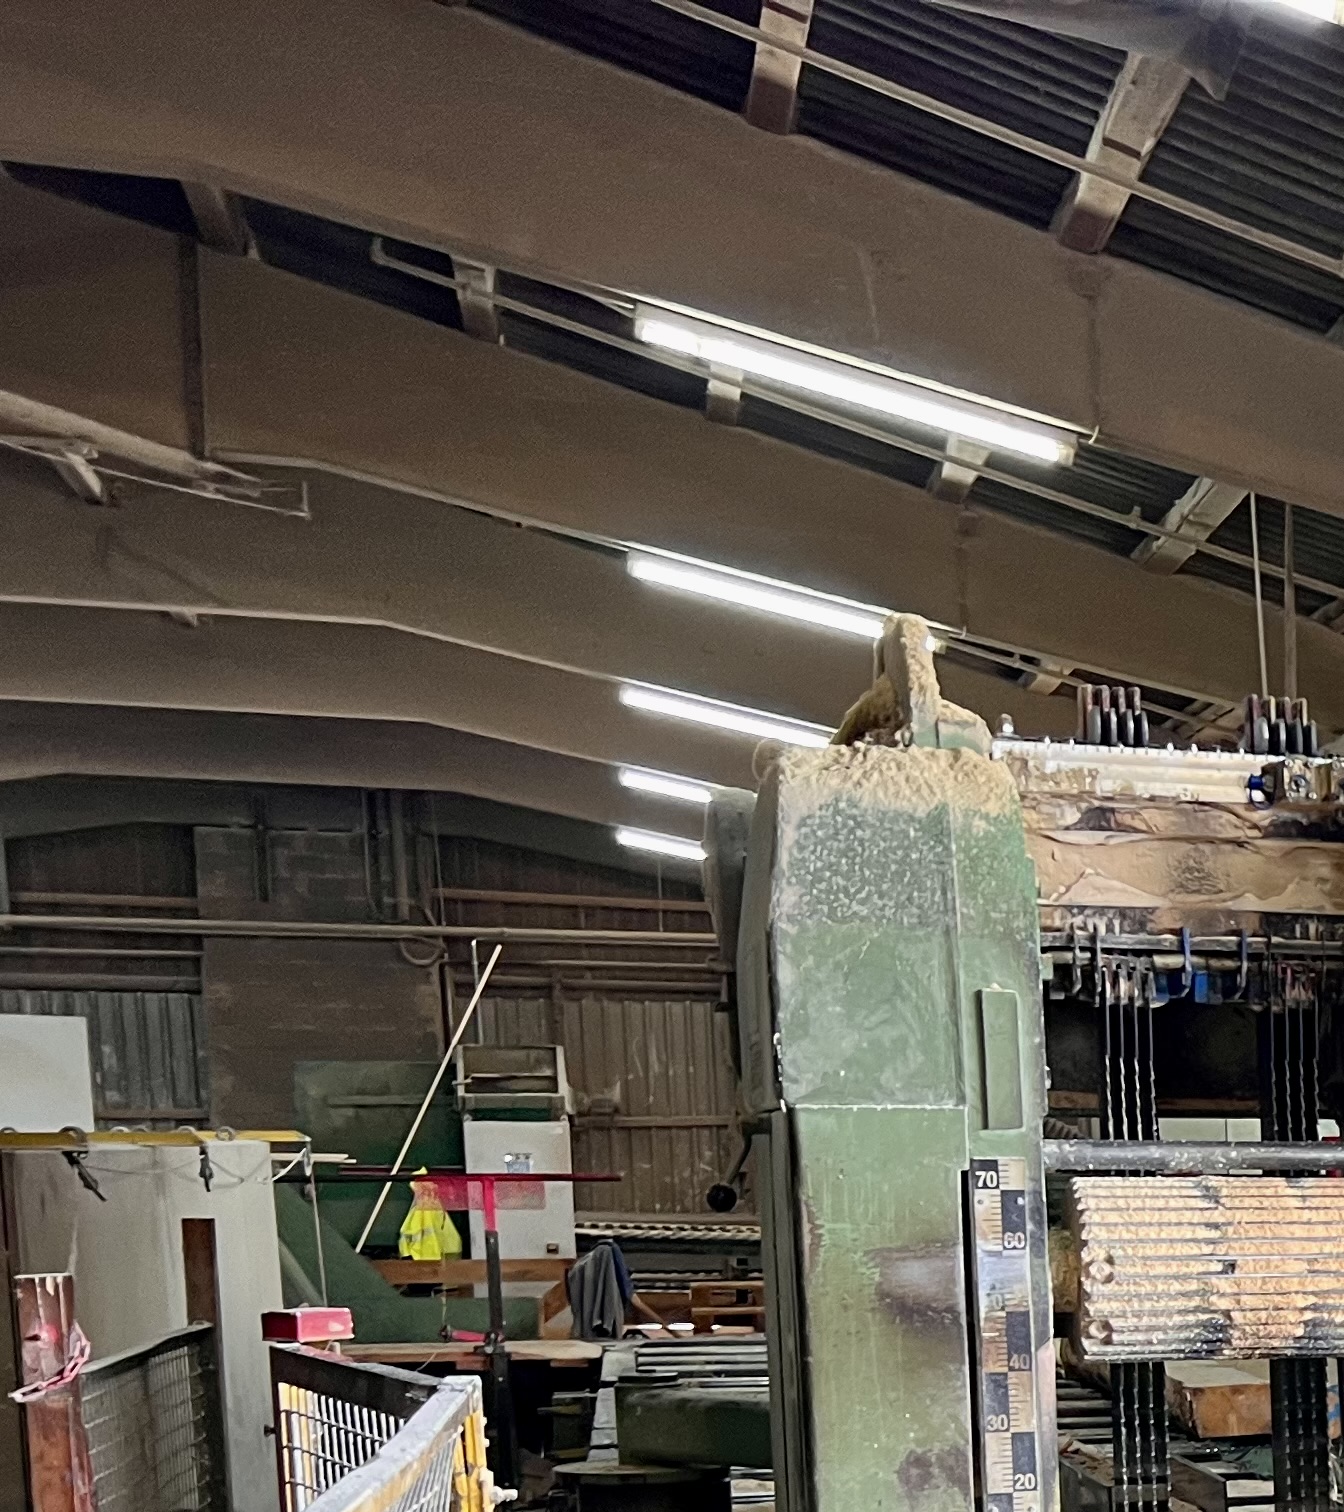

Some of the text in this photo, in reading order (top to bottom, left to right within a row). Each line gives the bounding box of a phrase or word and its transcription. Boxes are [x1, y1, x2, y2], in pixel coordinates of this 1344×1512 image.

[975, 1170, 998, 1188] 70
[1003, 1231, 1026, 1249] 60
[1009, 1353, 1031, 1370] 40
[986, 1414, 1009, 1431] 30
[1014, 1473, 1036, 1490] 20
